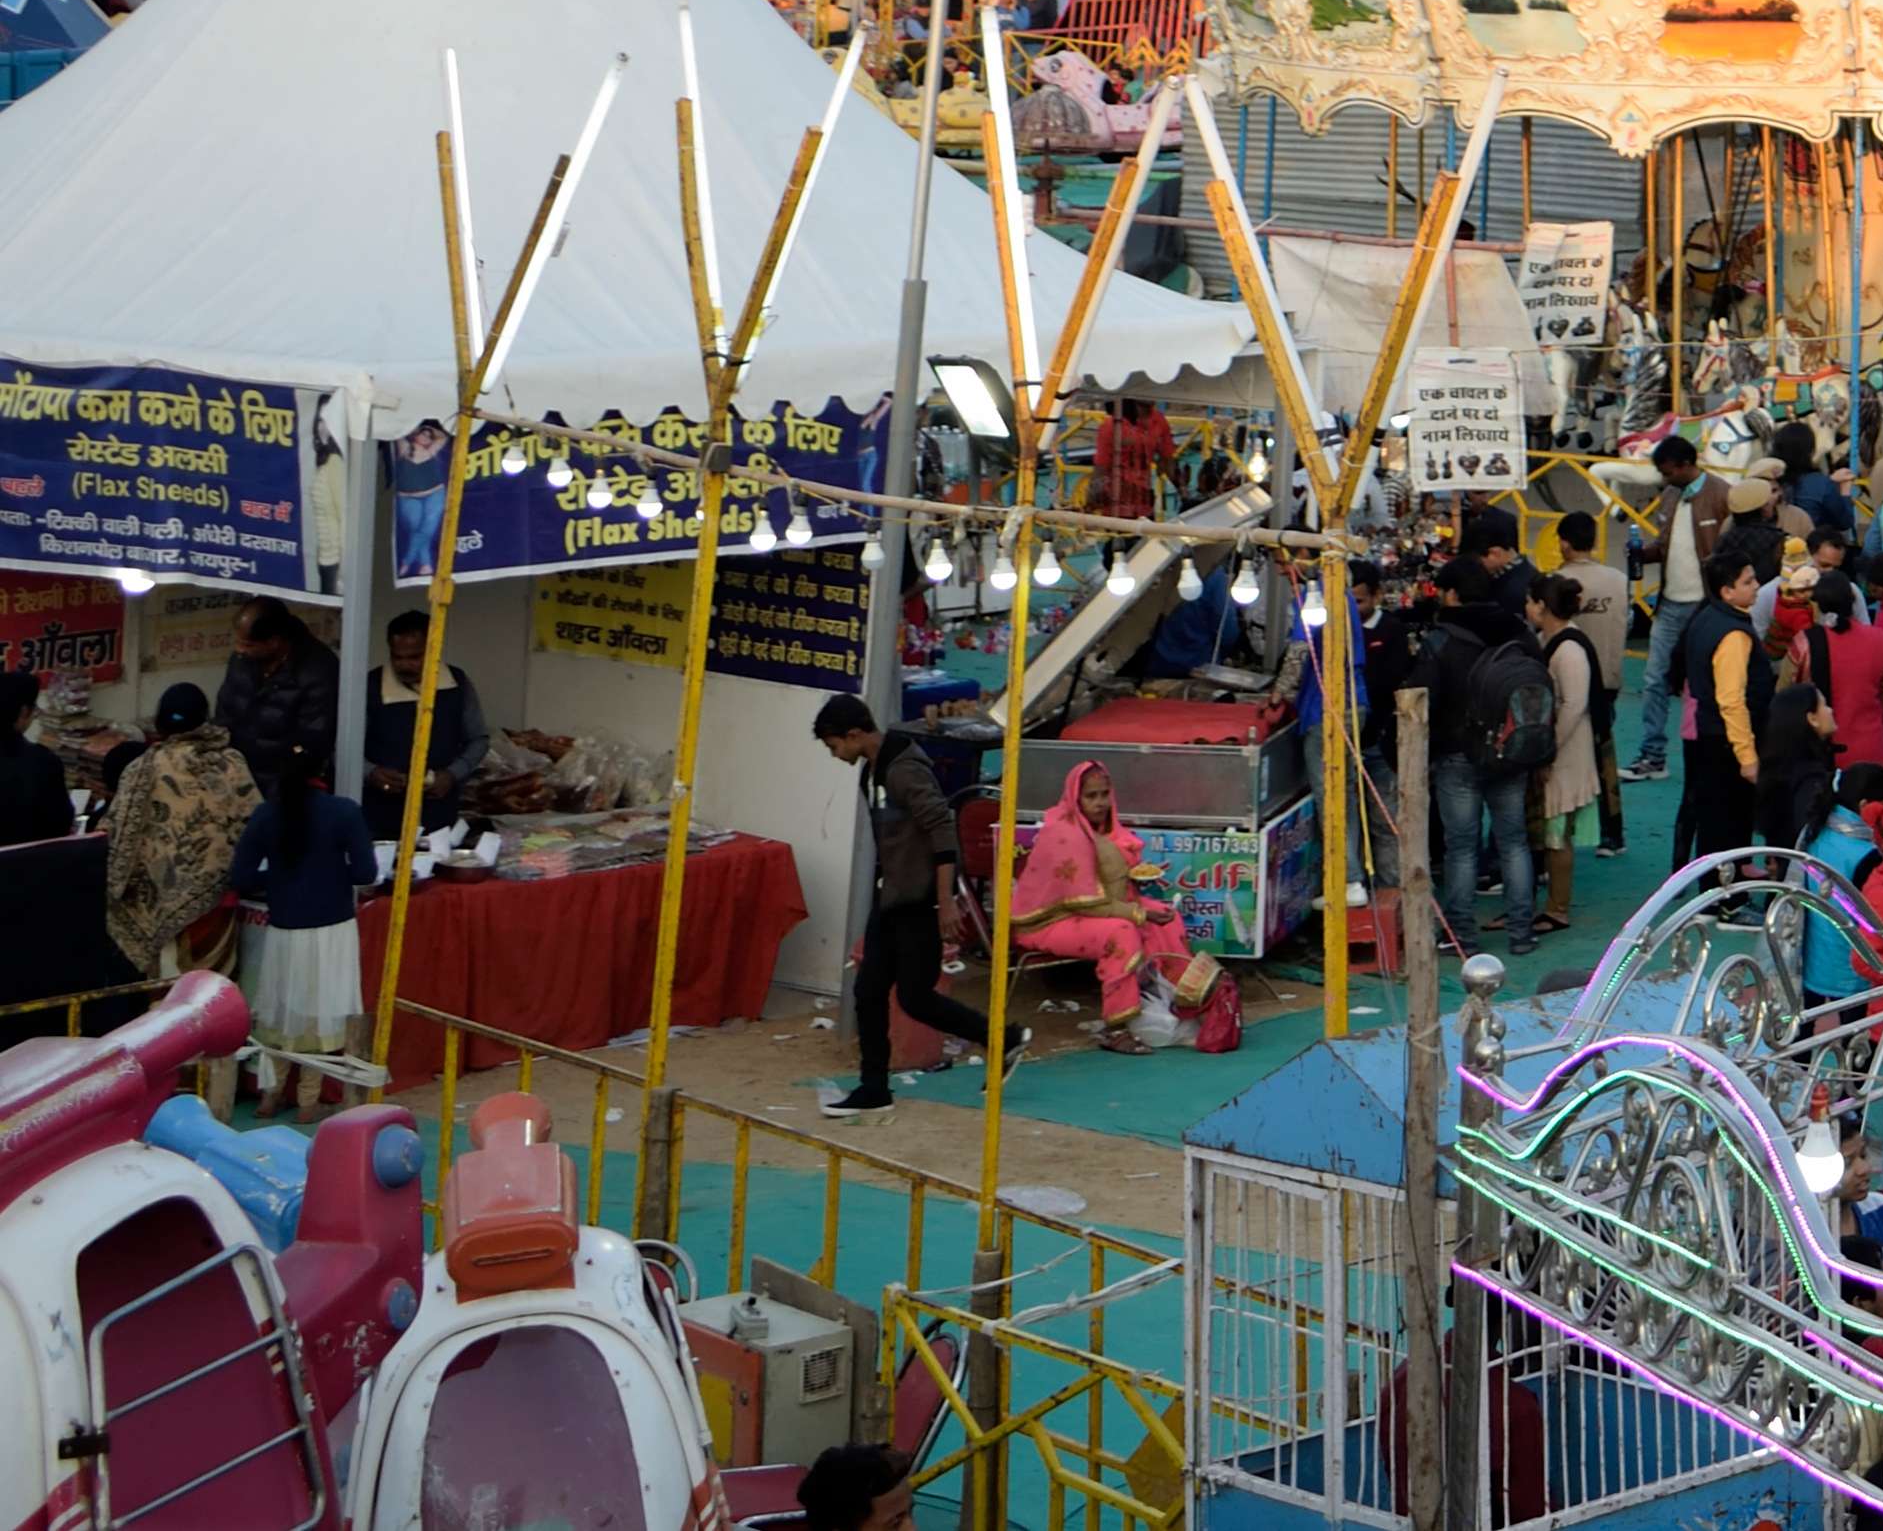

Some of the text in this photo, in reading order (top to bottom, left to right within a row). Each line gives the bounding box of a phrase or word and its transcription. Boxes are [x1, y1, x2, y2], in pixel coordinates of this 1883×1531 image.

[77, 389, 131, 424] कम
[137, 383, 201, 432] करने
[205, 388, 236, 436] के
[241, 389, 295, 448] लिए
[1419, 387, 1445, 401] एक
[784, 404, 843, 454] लिए
[1421, 428, 1451, 443] नाम
[147, 442, 229, 475] अलसी
[72, 472, 229, 513] (Flax Sheeds)
[564, 503, 759, 556] (Flax Sheds)
[18, 622, 118, 671] आँवला
